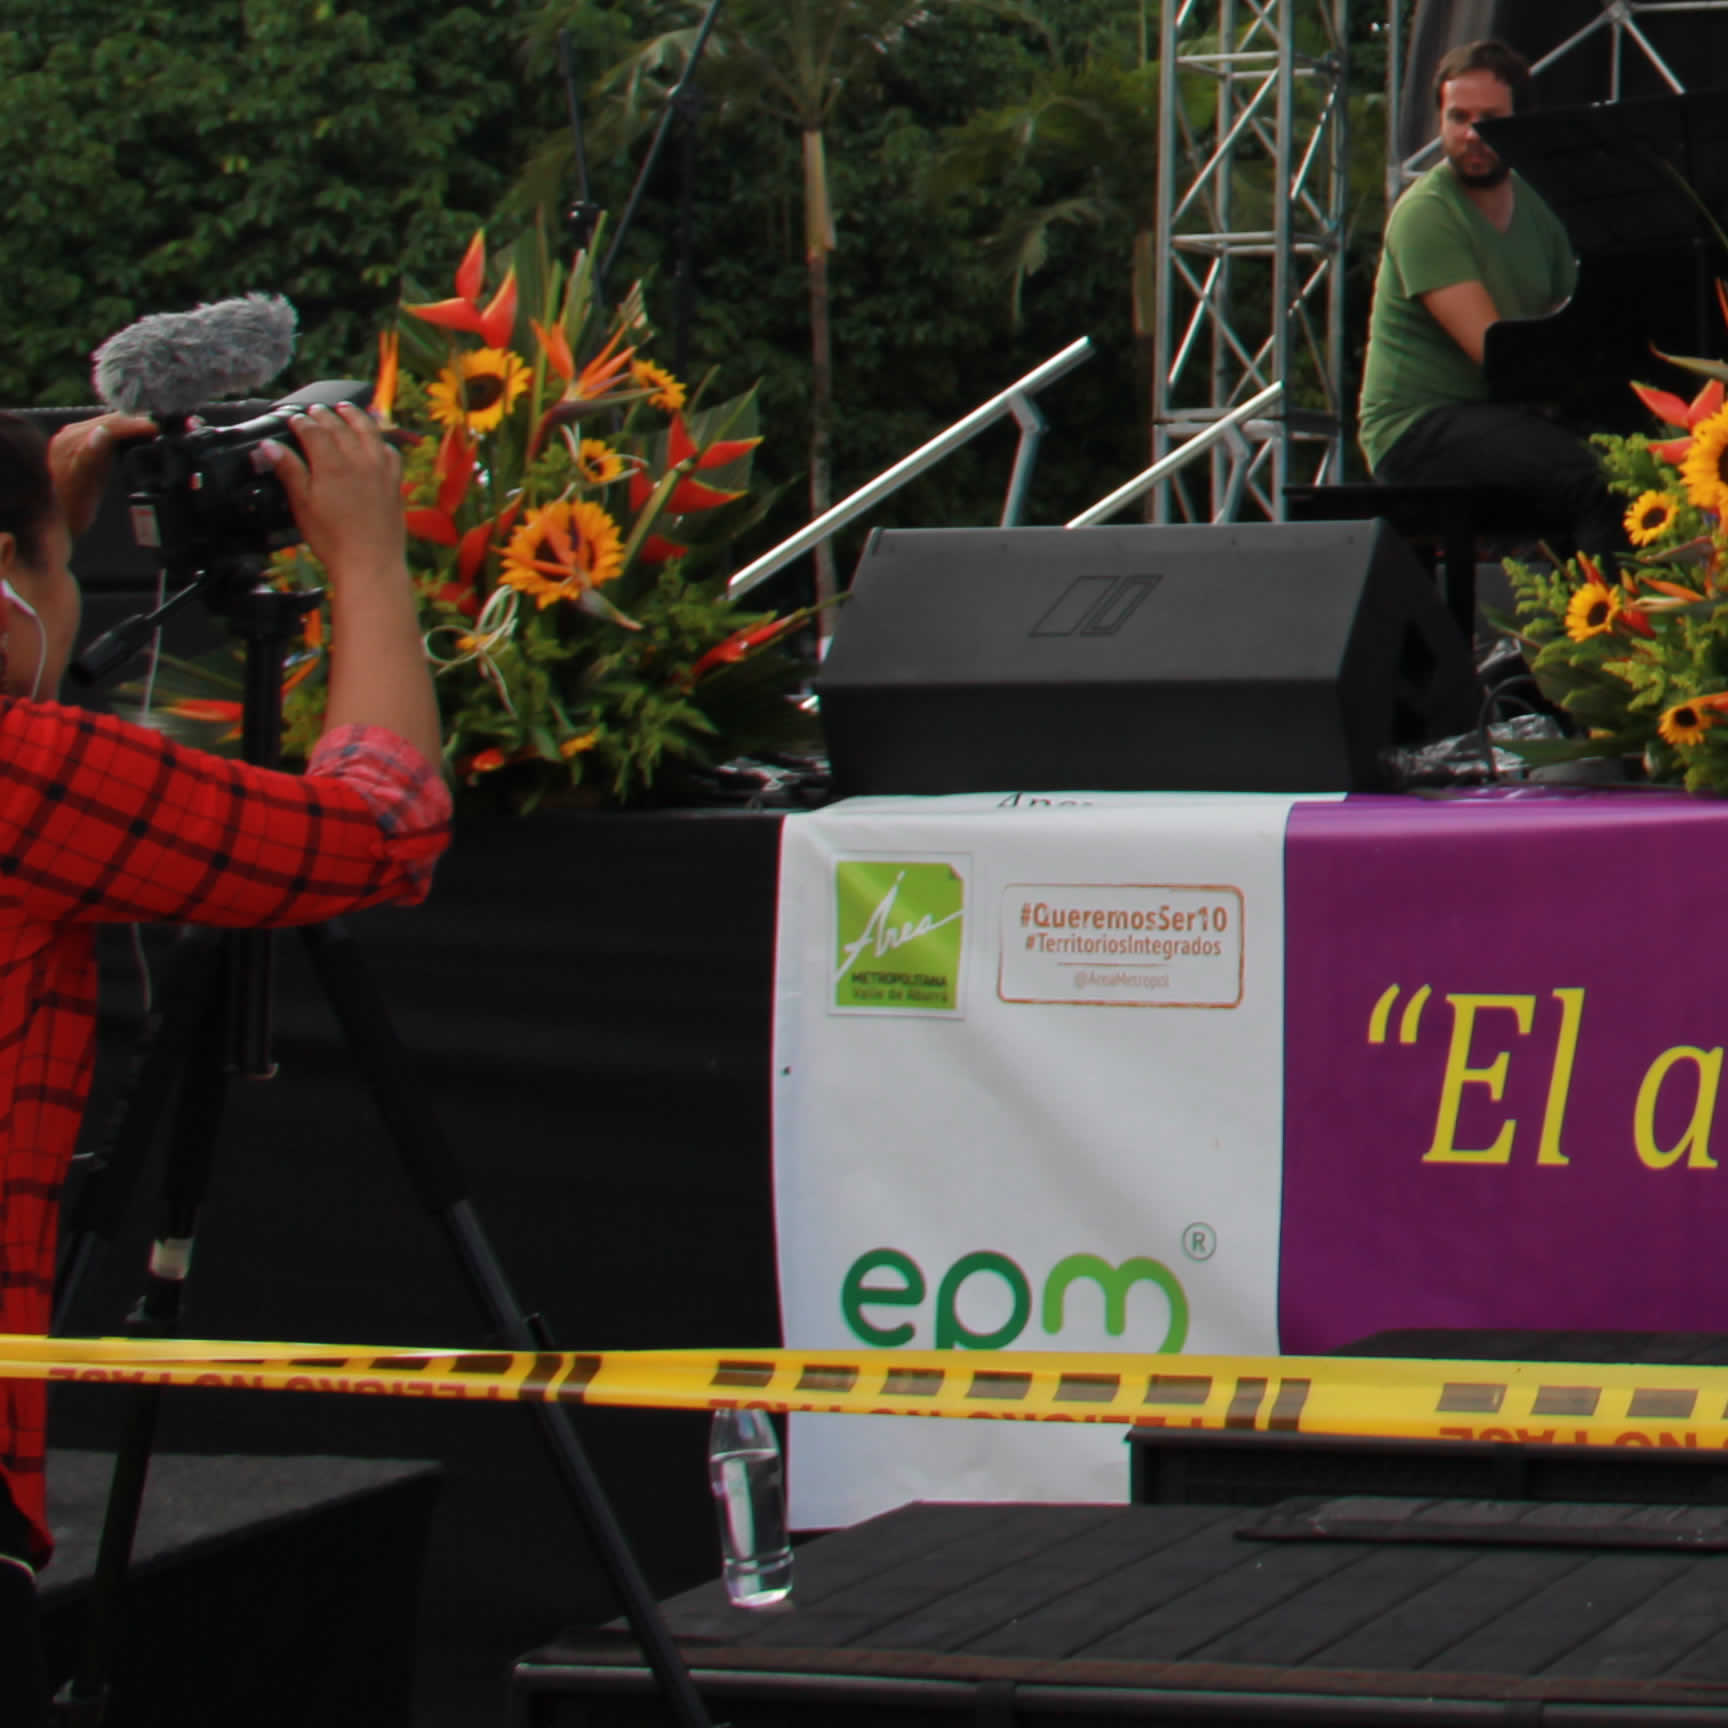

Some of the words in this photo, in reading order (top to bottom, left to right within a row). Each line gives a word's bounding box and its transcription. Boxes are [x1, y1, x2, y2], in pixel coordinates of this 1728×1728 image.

[1020, 902, 1230, 935] #QueremosSer10
[1025, 933, 1223, 961] #TerritoriosIntegrados
[1367, 983, 1586, 1165] “El
[841, 1246, 1190, 1355] epm
